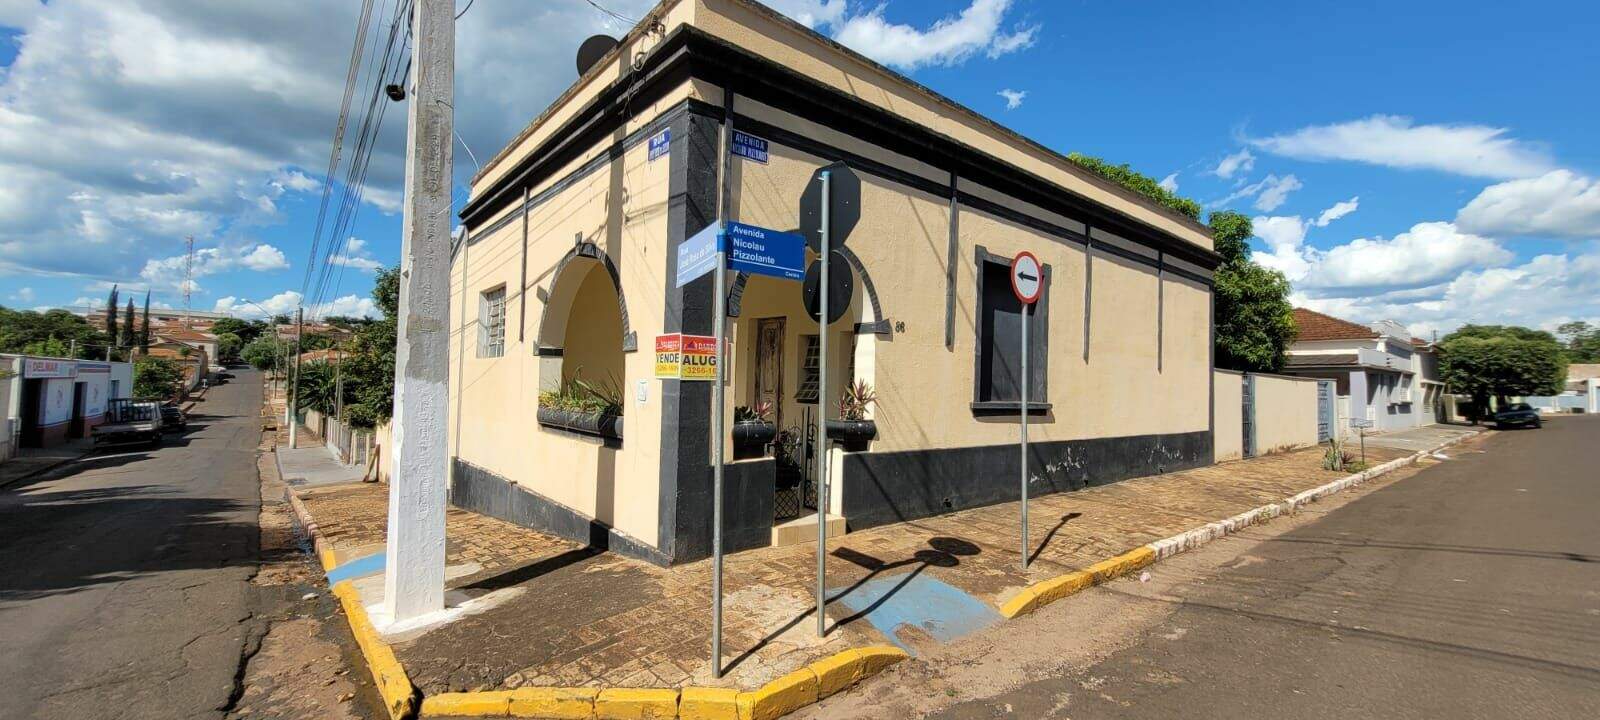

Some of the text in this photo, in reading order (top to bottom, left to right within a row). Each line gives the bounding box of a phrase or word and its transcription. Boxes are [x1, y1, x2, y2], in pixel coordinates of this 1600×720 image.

[654, 133, 665, 147] RUA
[735, 132, 765, 149] AVENIDA
[733, 225, 765, 239] Avenida
[733, 239, 765, 252] Nicolau
[733, 249, 775, 265] Pizzolante
[656, 352, 680, 364] VENDE
[682, 355, 716, 366] ALUG
[687, 366, 716, 375] 3266-16
